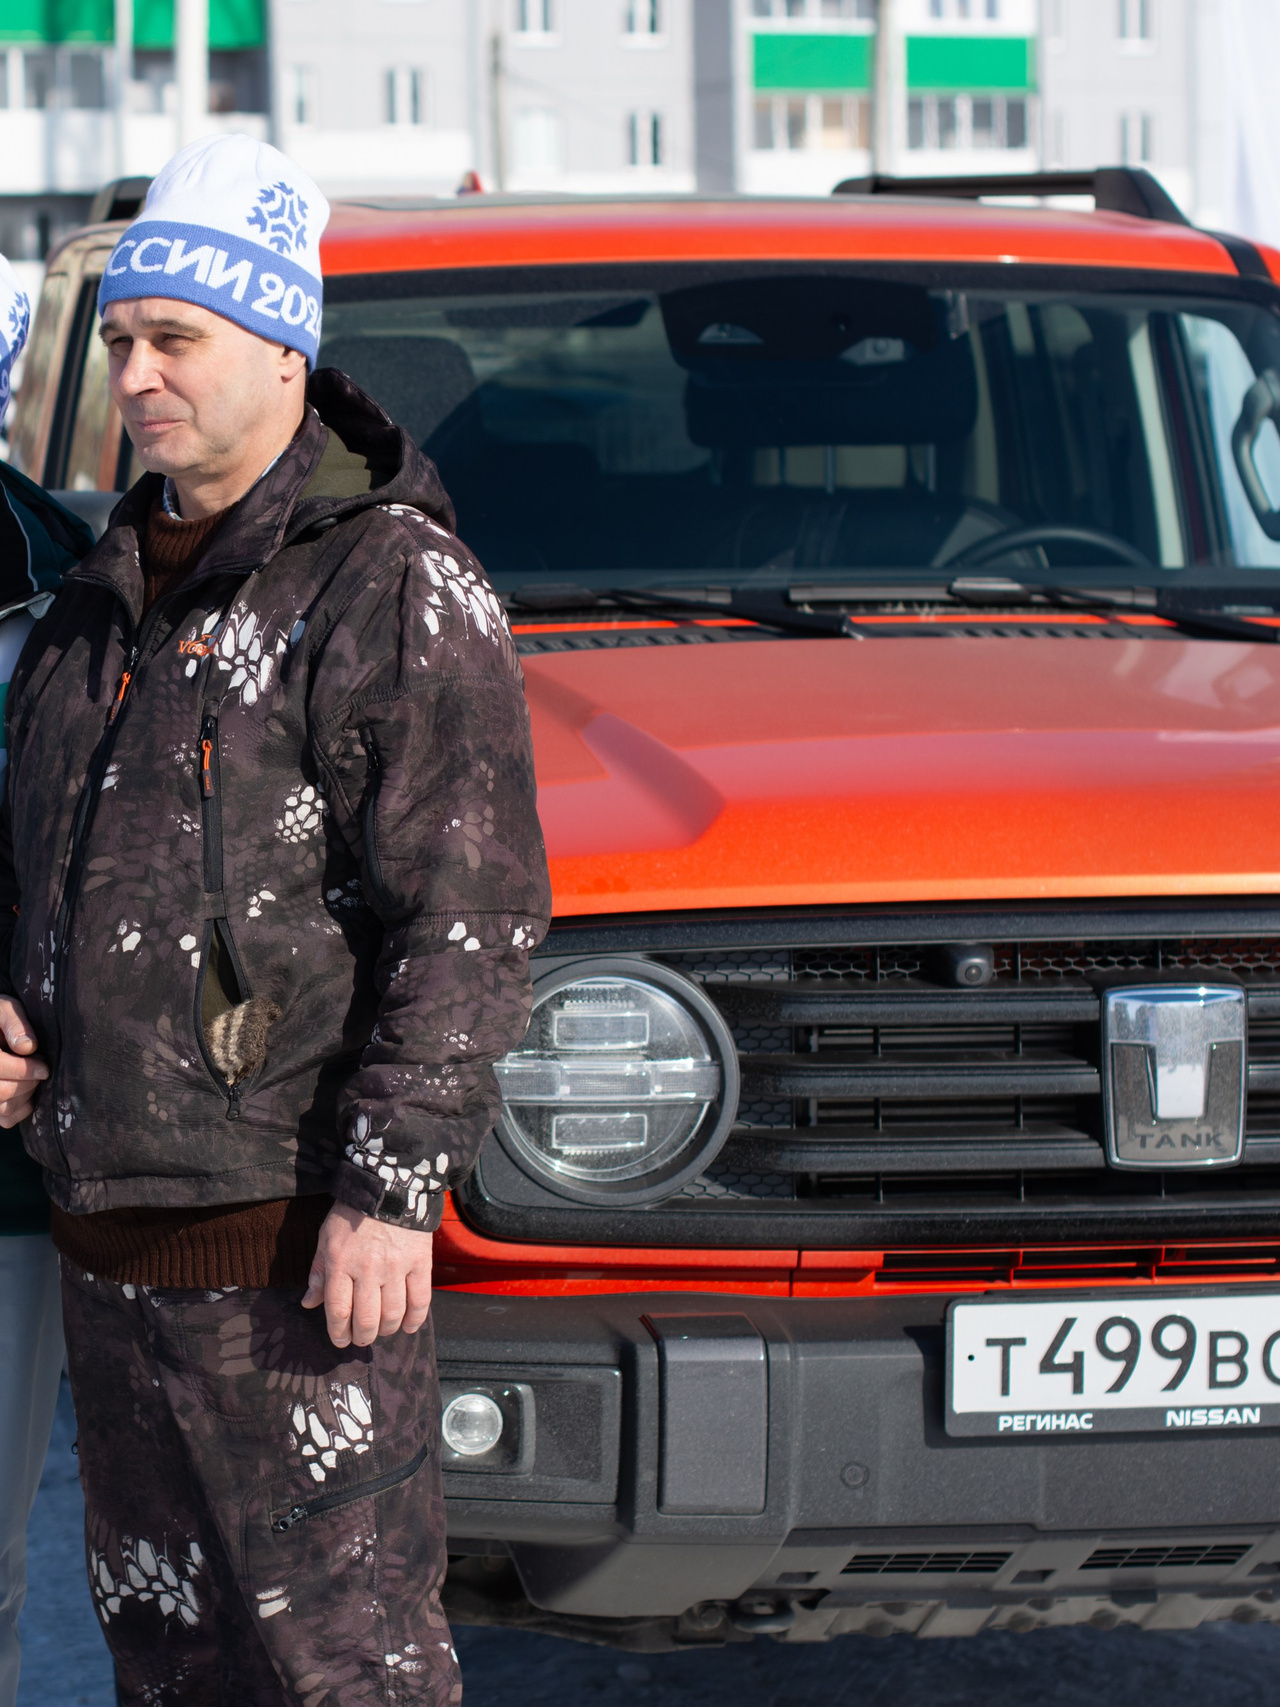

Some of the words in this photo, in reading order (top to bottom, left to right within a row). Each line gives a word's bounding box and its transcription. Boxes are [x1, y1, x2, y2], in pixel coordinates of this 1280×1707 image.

[251, 272, 323, 348] 202
[1135, 1133, 1228, 1153] TANK
[998, 1413, 1093, 1432] РЕГИНАС
[1166, 1407, 1261, 1427] NISSAN
